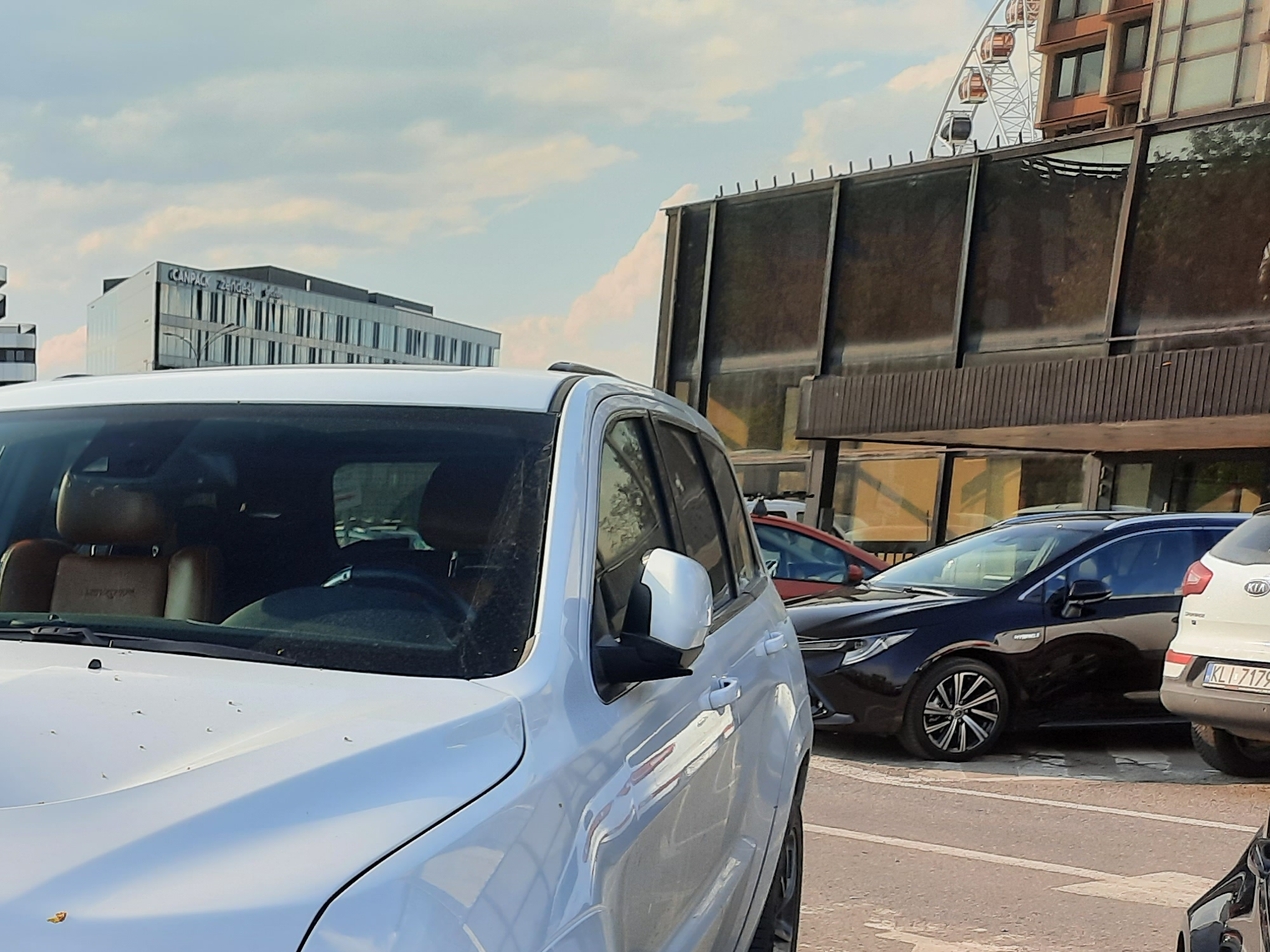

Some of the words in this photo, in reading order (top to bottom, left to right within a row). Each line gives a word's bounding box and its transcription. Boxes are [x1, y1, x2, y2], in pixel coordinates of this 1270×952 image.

[168, 268, 211, 288] CANPACK
[1247, 582, 1266, 593] KIA
[1211, 665, 1235, 684] KLI
